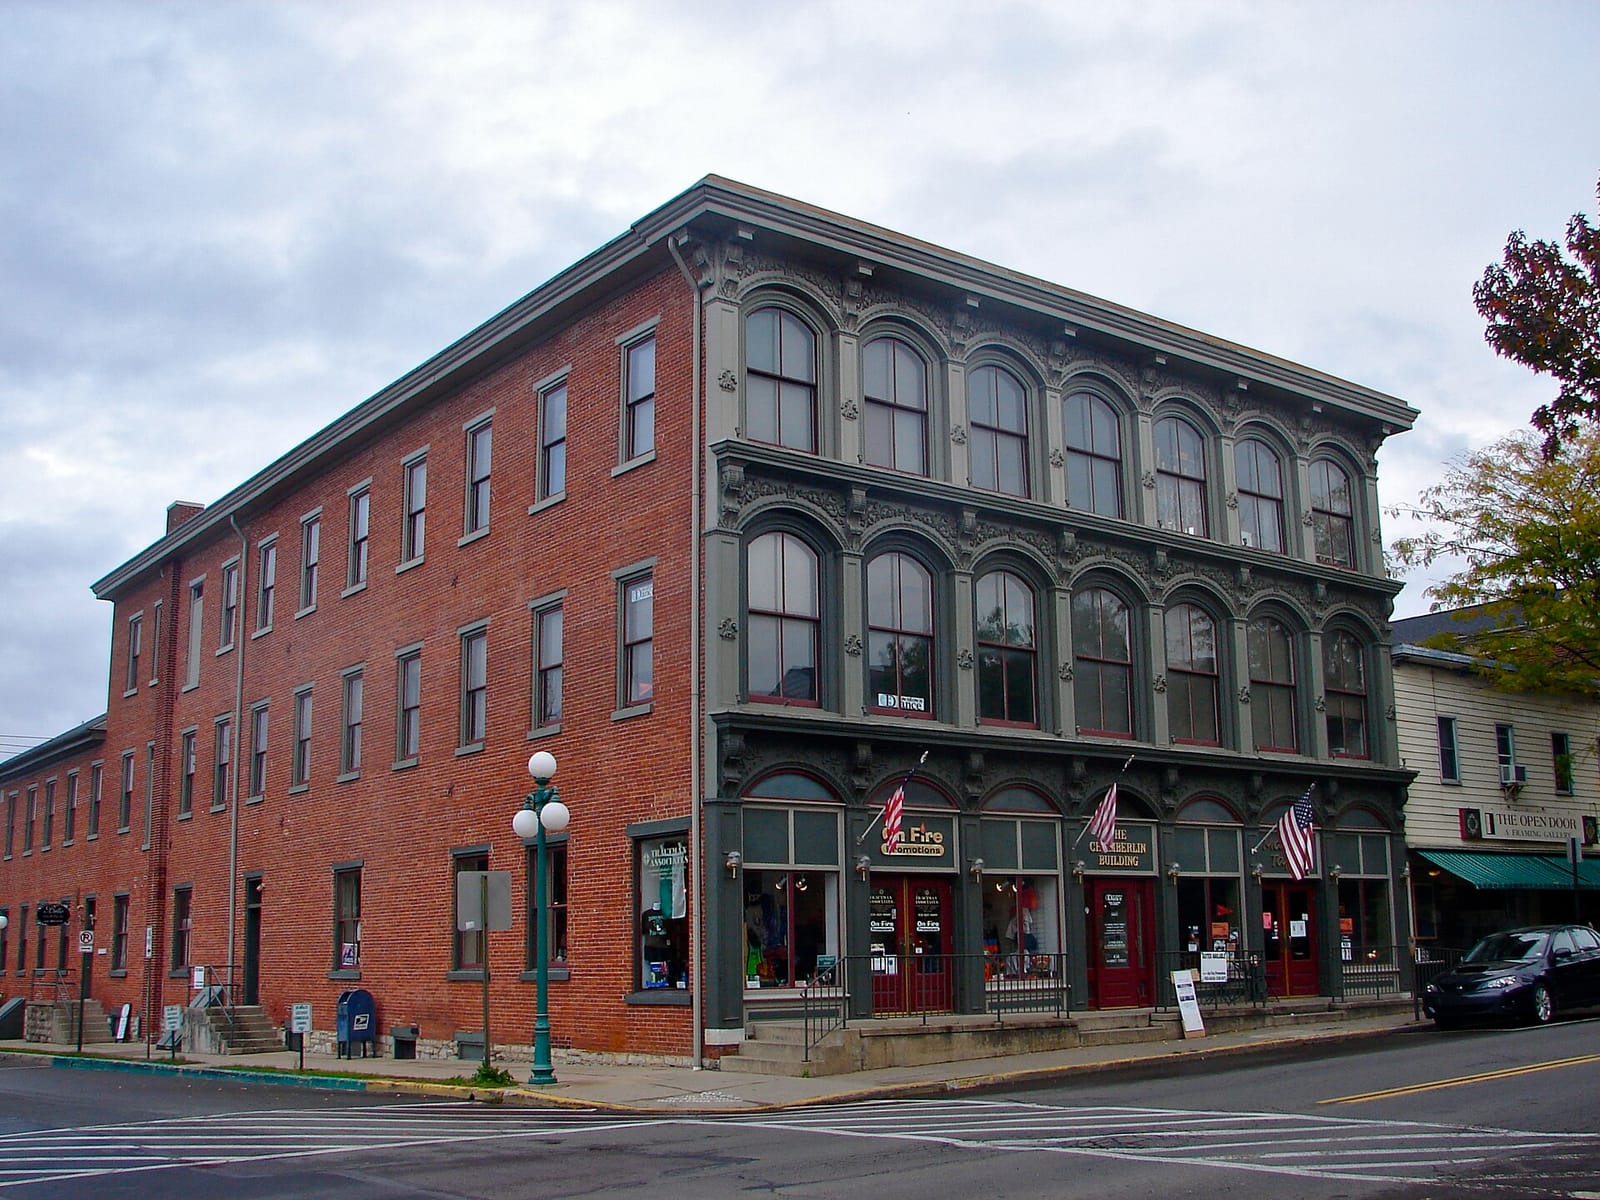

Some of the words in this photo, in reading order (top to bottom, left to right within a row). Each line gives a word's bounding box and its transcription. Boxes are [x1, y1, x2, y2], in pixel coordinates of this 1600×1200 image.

[1496, 813, 1518, 826] THE
[1520, 814, 1547, 828] OPEN
[1549, 816, 1577, 830] DOOR
[910, 826, 943, 843] Fire
[1114, 829, 1127, 840] HE
[1512, 829, 1542, 838] FRAMING
[1089, 841, 1147, 854] CHMBERLIN
[1099, 854, 1139, 867] BUILDING
